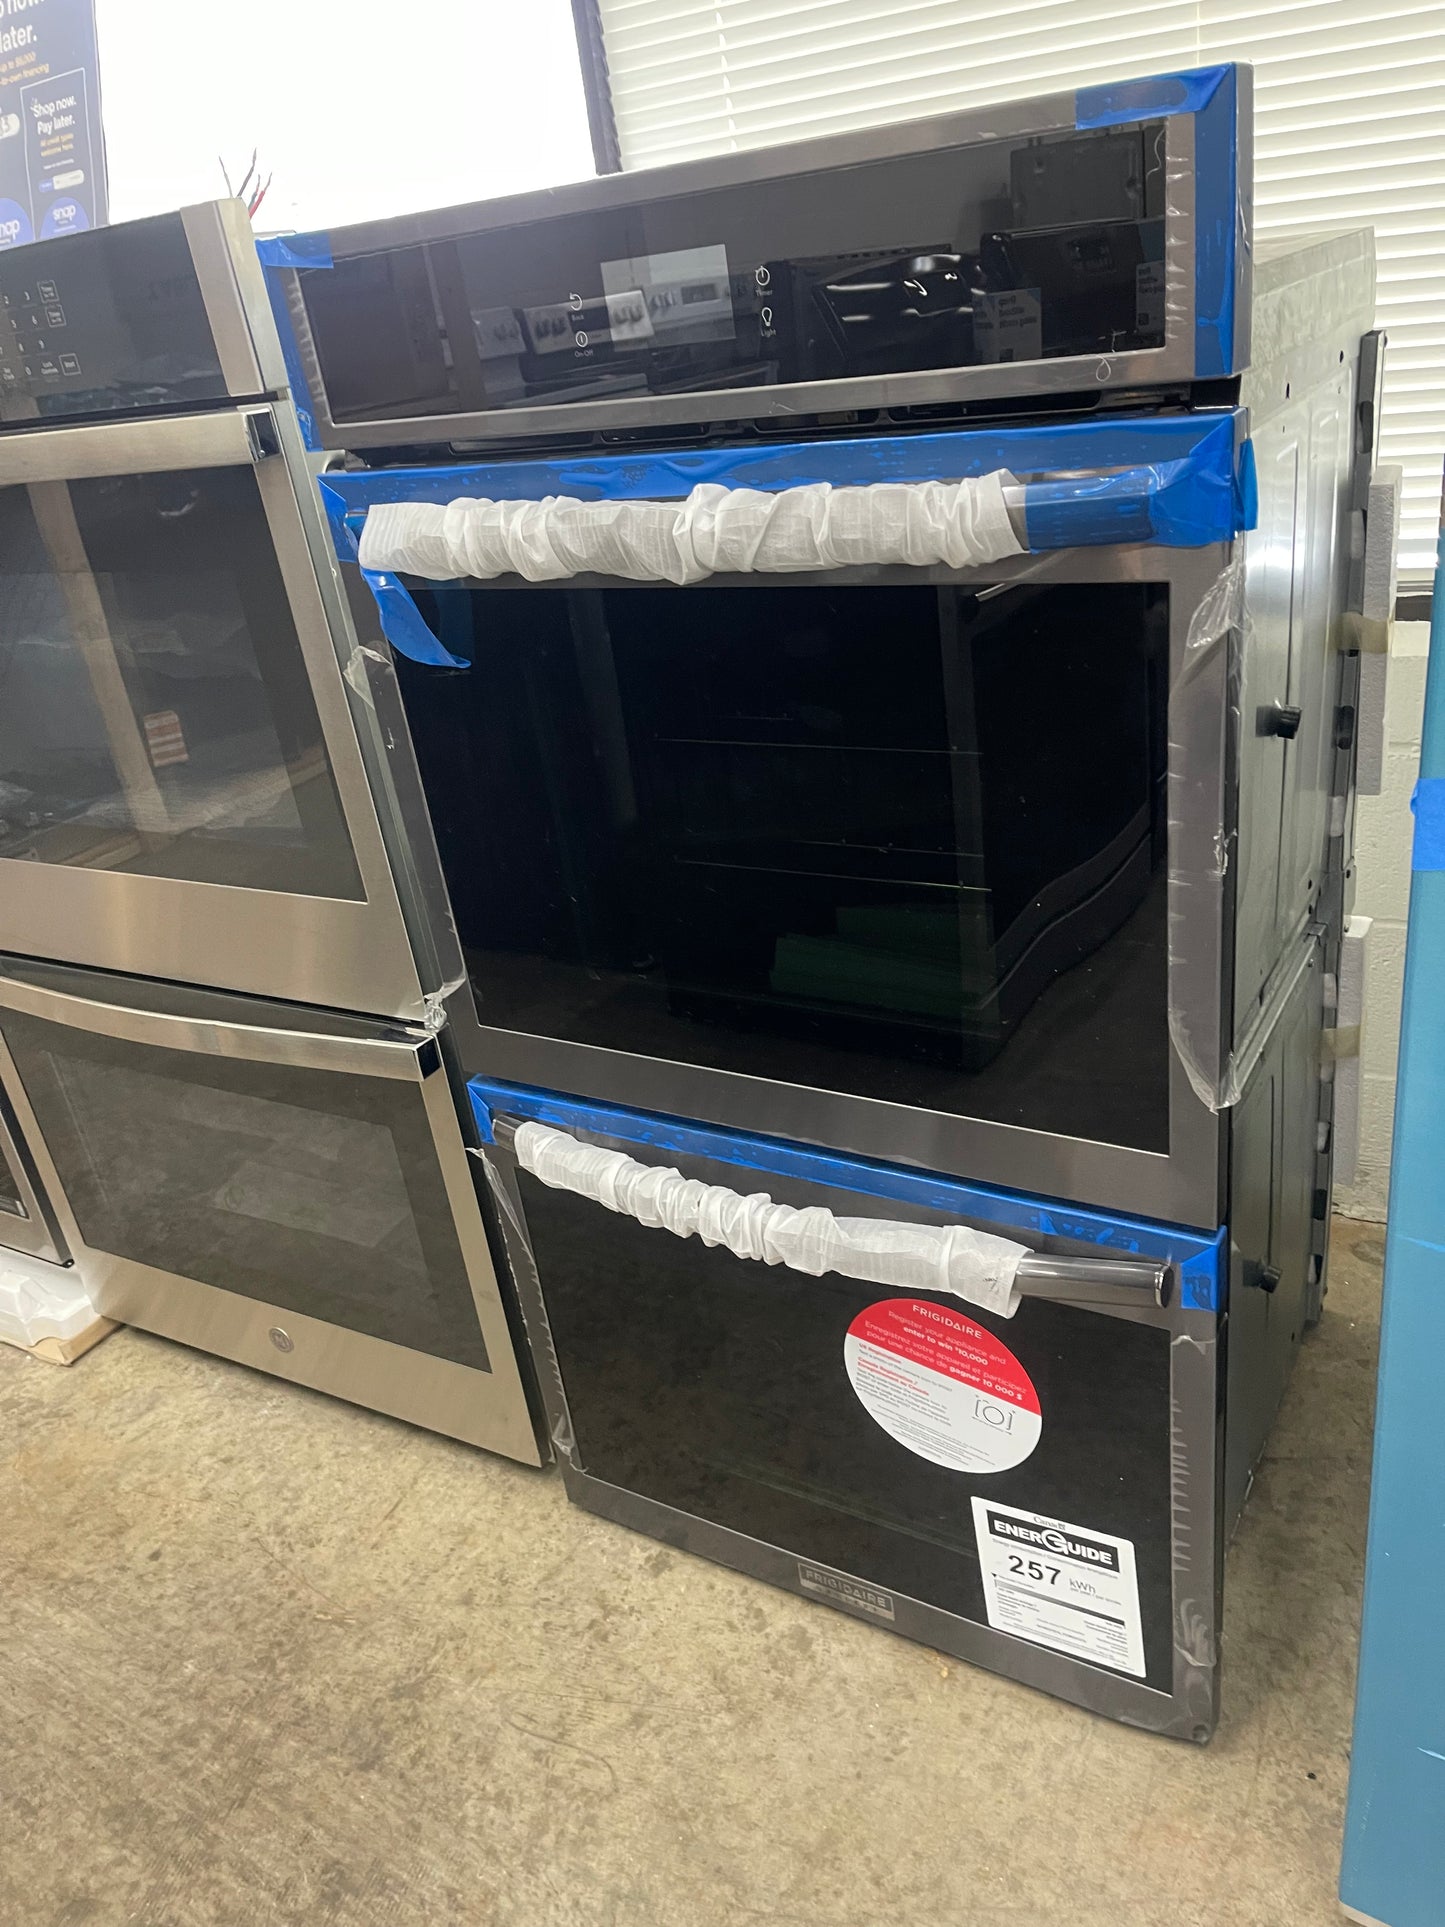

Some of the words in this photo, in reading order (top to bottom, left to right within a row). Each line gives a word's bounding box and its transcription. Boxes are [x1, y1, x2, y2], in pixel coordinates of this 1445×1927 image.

[33, 102, 55, 117] Shop
[56, 96, 76, 111] now.
[37, 119, 52, 135] Pay
[53, 115, 75, 131] later.
[888, 1310, 922, 1330] Register
[924, 1327, 943, 1340] your
[945, 1335, 988, 1358] appliance
[989, 1353, 1006, 1365] and
[903, 1326, 925, 1339] enter
[926, 1335, 936, 1344] to
[937, 1341, 953, 1352] win
[912, 1304, 983, 1340] FRIGIDAIRE
[864, 1320, 911, 1346] Enregistrez
[912, 1341, 935, 1355] votre
[936, 1351, 971, 1371] appareil
[971, 1365, 981, 1375] et
[983, 1371, 1027, 1395] participez
[866, 1330, 886, 1343] pour
[887, 1339, 904, 1350] une
[904, 1346, 936, 1363] chance
[936, 1359, 948, 1369] de
[949, 1366, 980, 1383] gagner
[982, 1378, 993, 1388] 10
[994, 1384, 1015, 1398] 000
[1016, 1393, 1023, 1401] $
[993, 1519, 1113, 1566] ENERGUIDE
[805, 1569, 887, 1607] FRIGIDAIRE
[1008, 1555, 1061, 1585] 257
[1069, 1578, 1096, 1595] kWh
